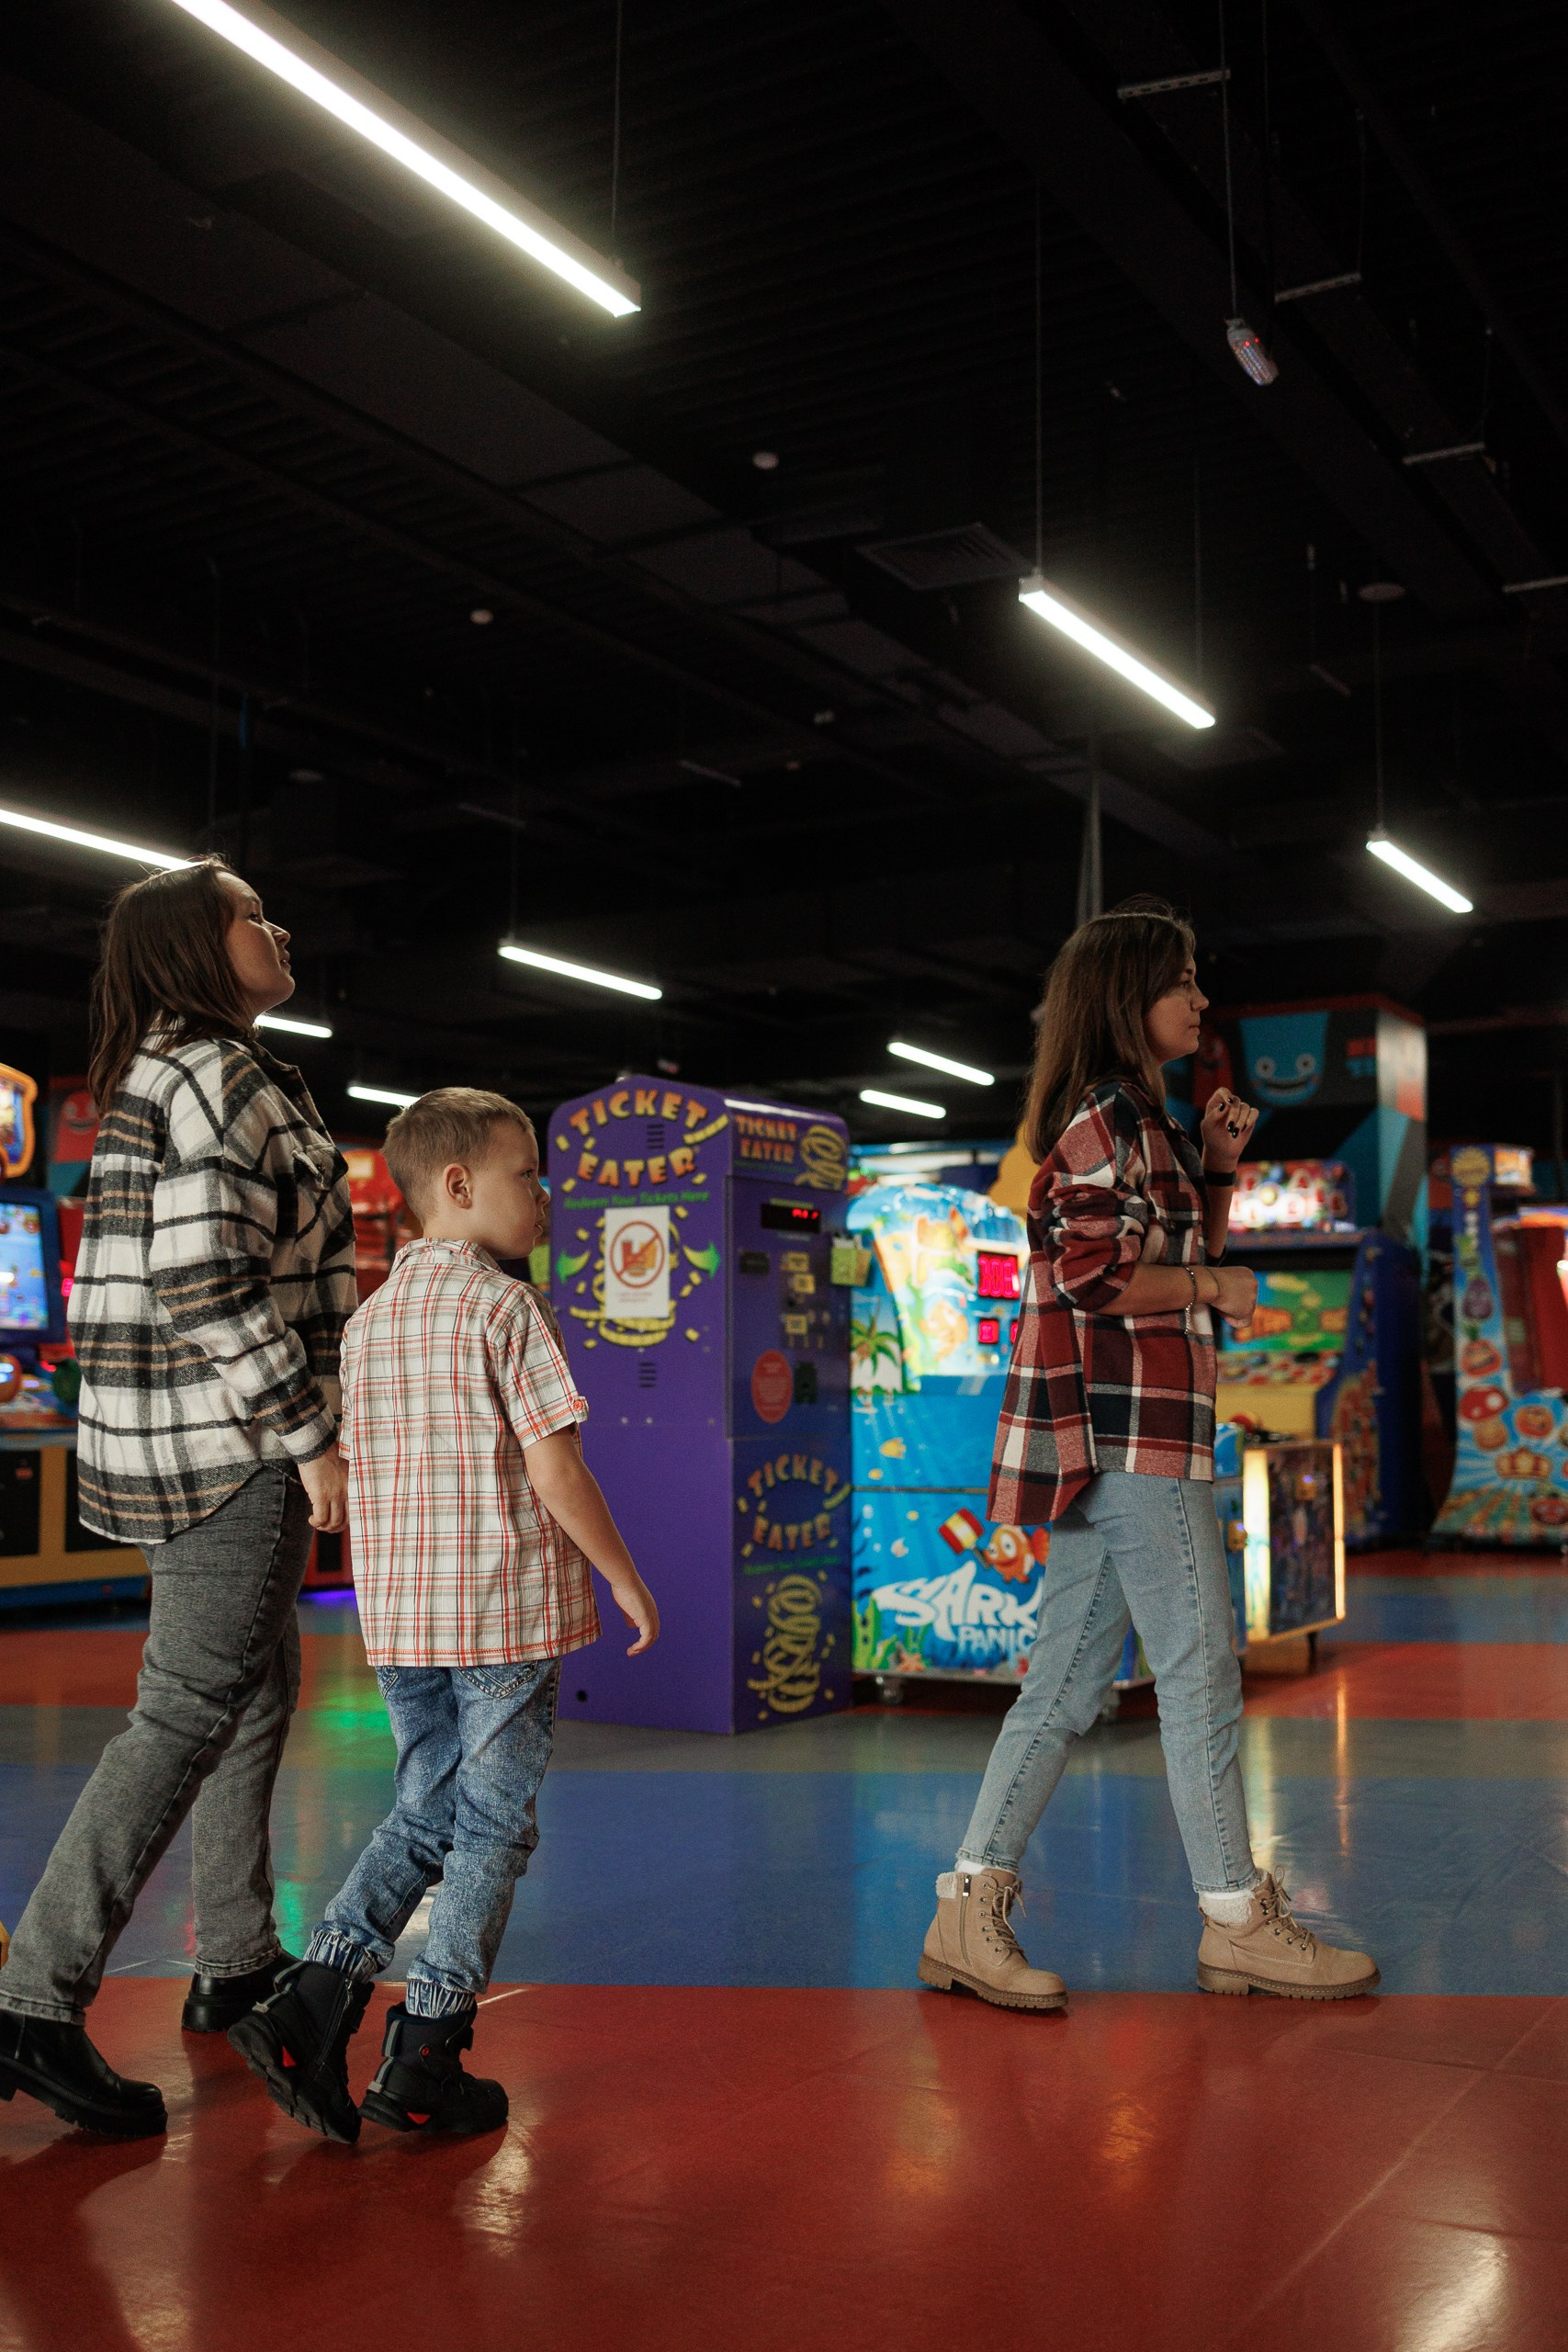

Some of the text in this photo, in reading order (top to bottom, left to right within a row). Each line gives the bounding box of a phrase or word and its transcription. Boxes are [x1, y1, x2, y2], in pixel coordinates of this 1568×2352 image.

[570, 1089, 708, 1136] TICKET
[736, 1114, 797, 1141] TICKET
[577, 1147, 696, 1187] EATER
[740, 1139, 794, 1165] EATER
[748, 1453, 839, 1497] TICKET
[753, 1513, 831, 1553] EATER
[958, 1625, 1038, 1655] PANIC
